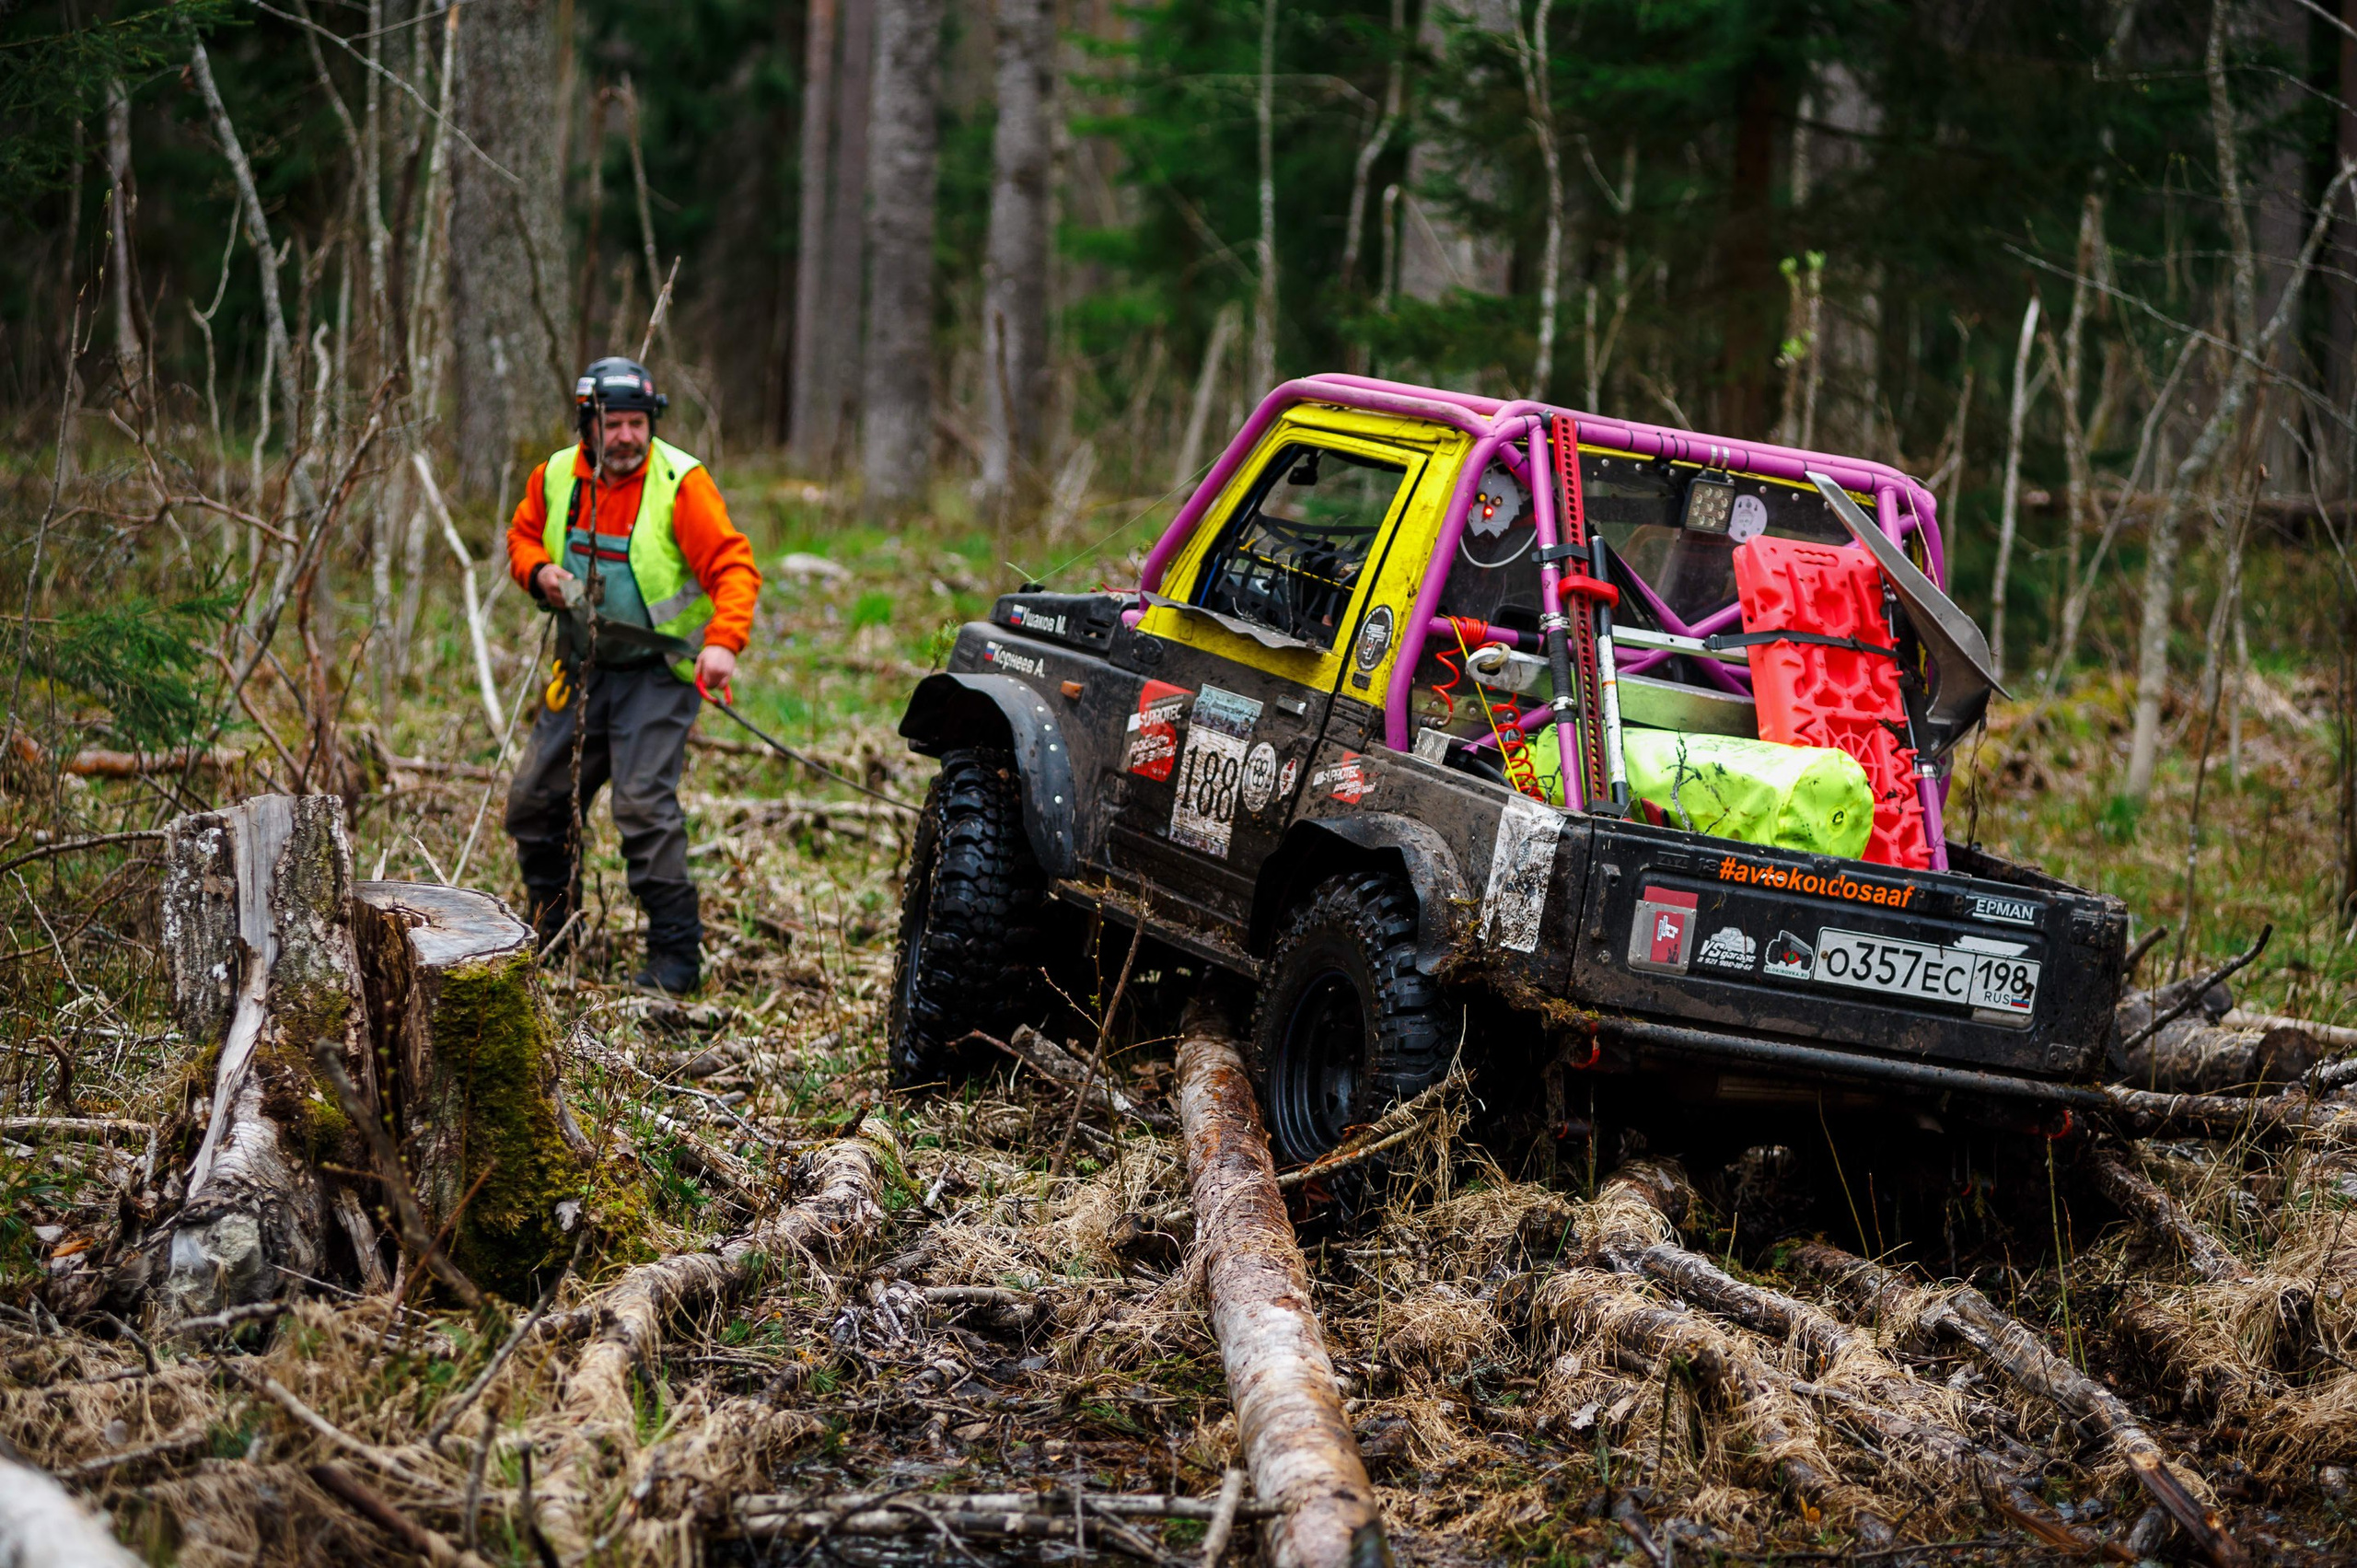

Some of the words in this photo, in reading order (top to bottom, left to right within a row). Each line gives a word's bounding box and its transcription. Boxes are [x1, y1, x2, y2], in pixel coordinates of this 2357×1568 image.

[1021, 607, 1055, 633] Ушаков
[1054, 614, 1066, 635] М.
[993, 644, 1034, 674] Корнеев
[1033, 657, 1045, 679] А.
[1180, 745, 1237, 823] 188
[1978, 959, 2027, 994] 198
[1984, 991, 2010, 1005] RUS
